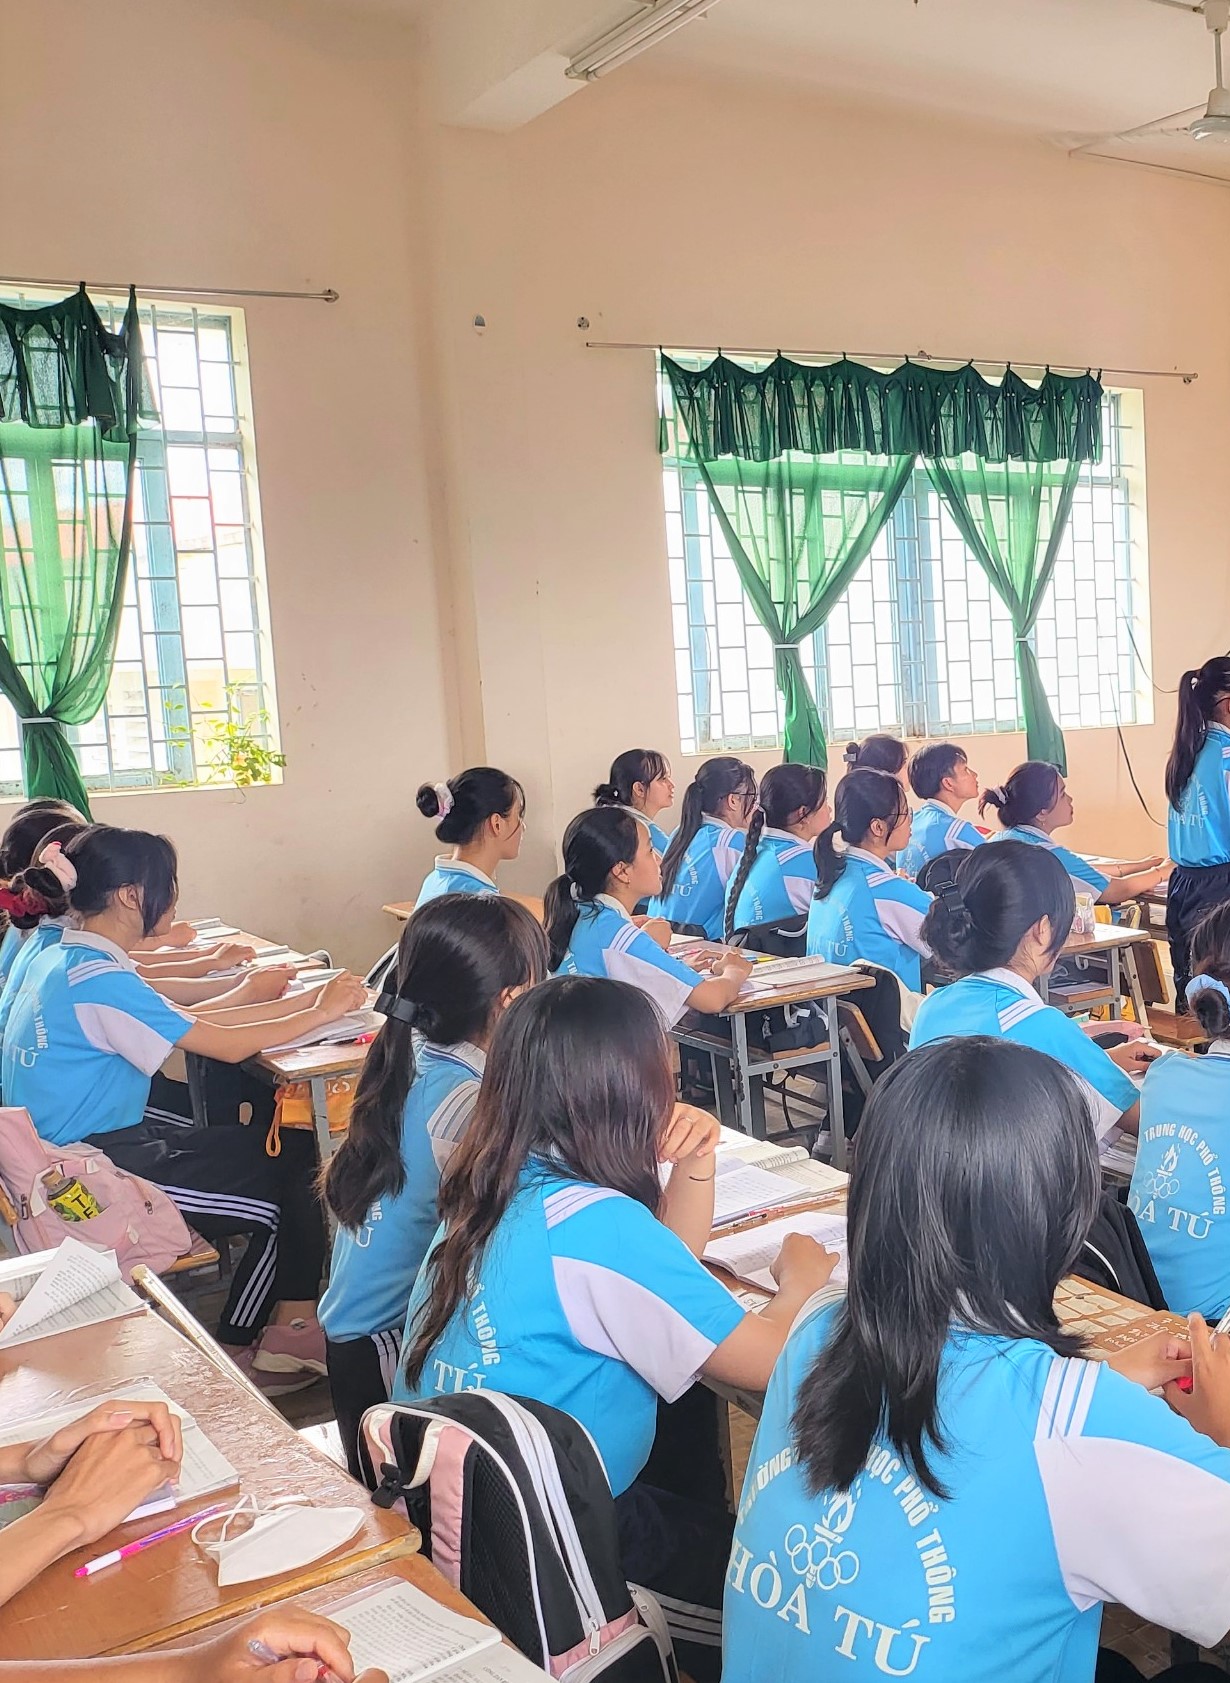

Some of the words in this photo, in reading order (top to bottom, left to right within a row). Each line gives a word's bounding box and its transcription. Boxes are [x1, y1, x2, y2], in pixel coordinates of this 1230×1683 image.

[1144, 1122, 1177, 1143] TRUNG
[1178, 1124, 1199, 1146] HỌC
[1207, 1166, 1227, 1216] THÔNG
[1167, 1206, 1215, 1239] TÚ
[472, 1301, 501, 1366] THÔNG
[893, 1473, 939, 1527] PHỔ
[727, 1537, 811, 1635] HÒA
[833, 1604, 932, 1677] TÚ
[915, 1527, 957, 1624] THÔNG
